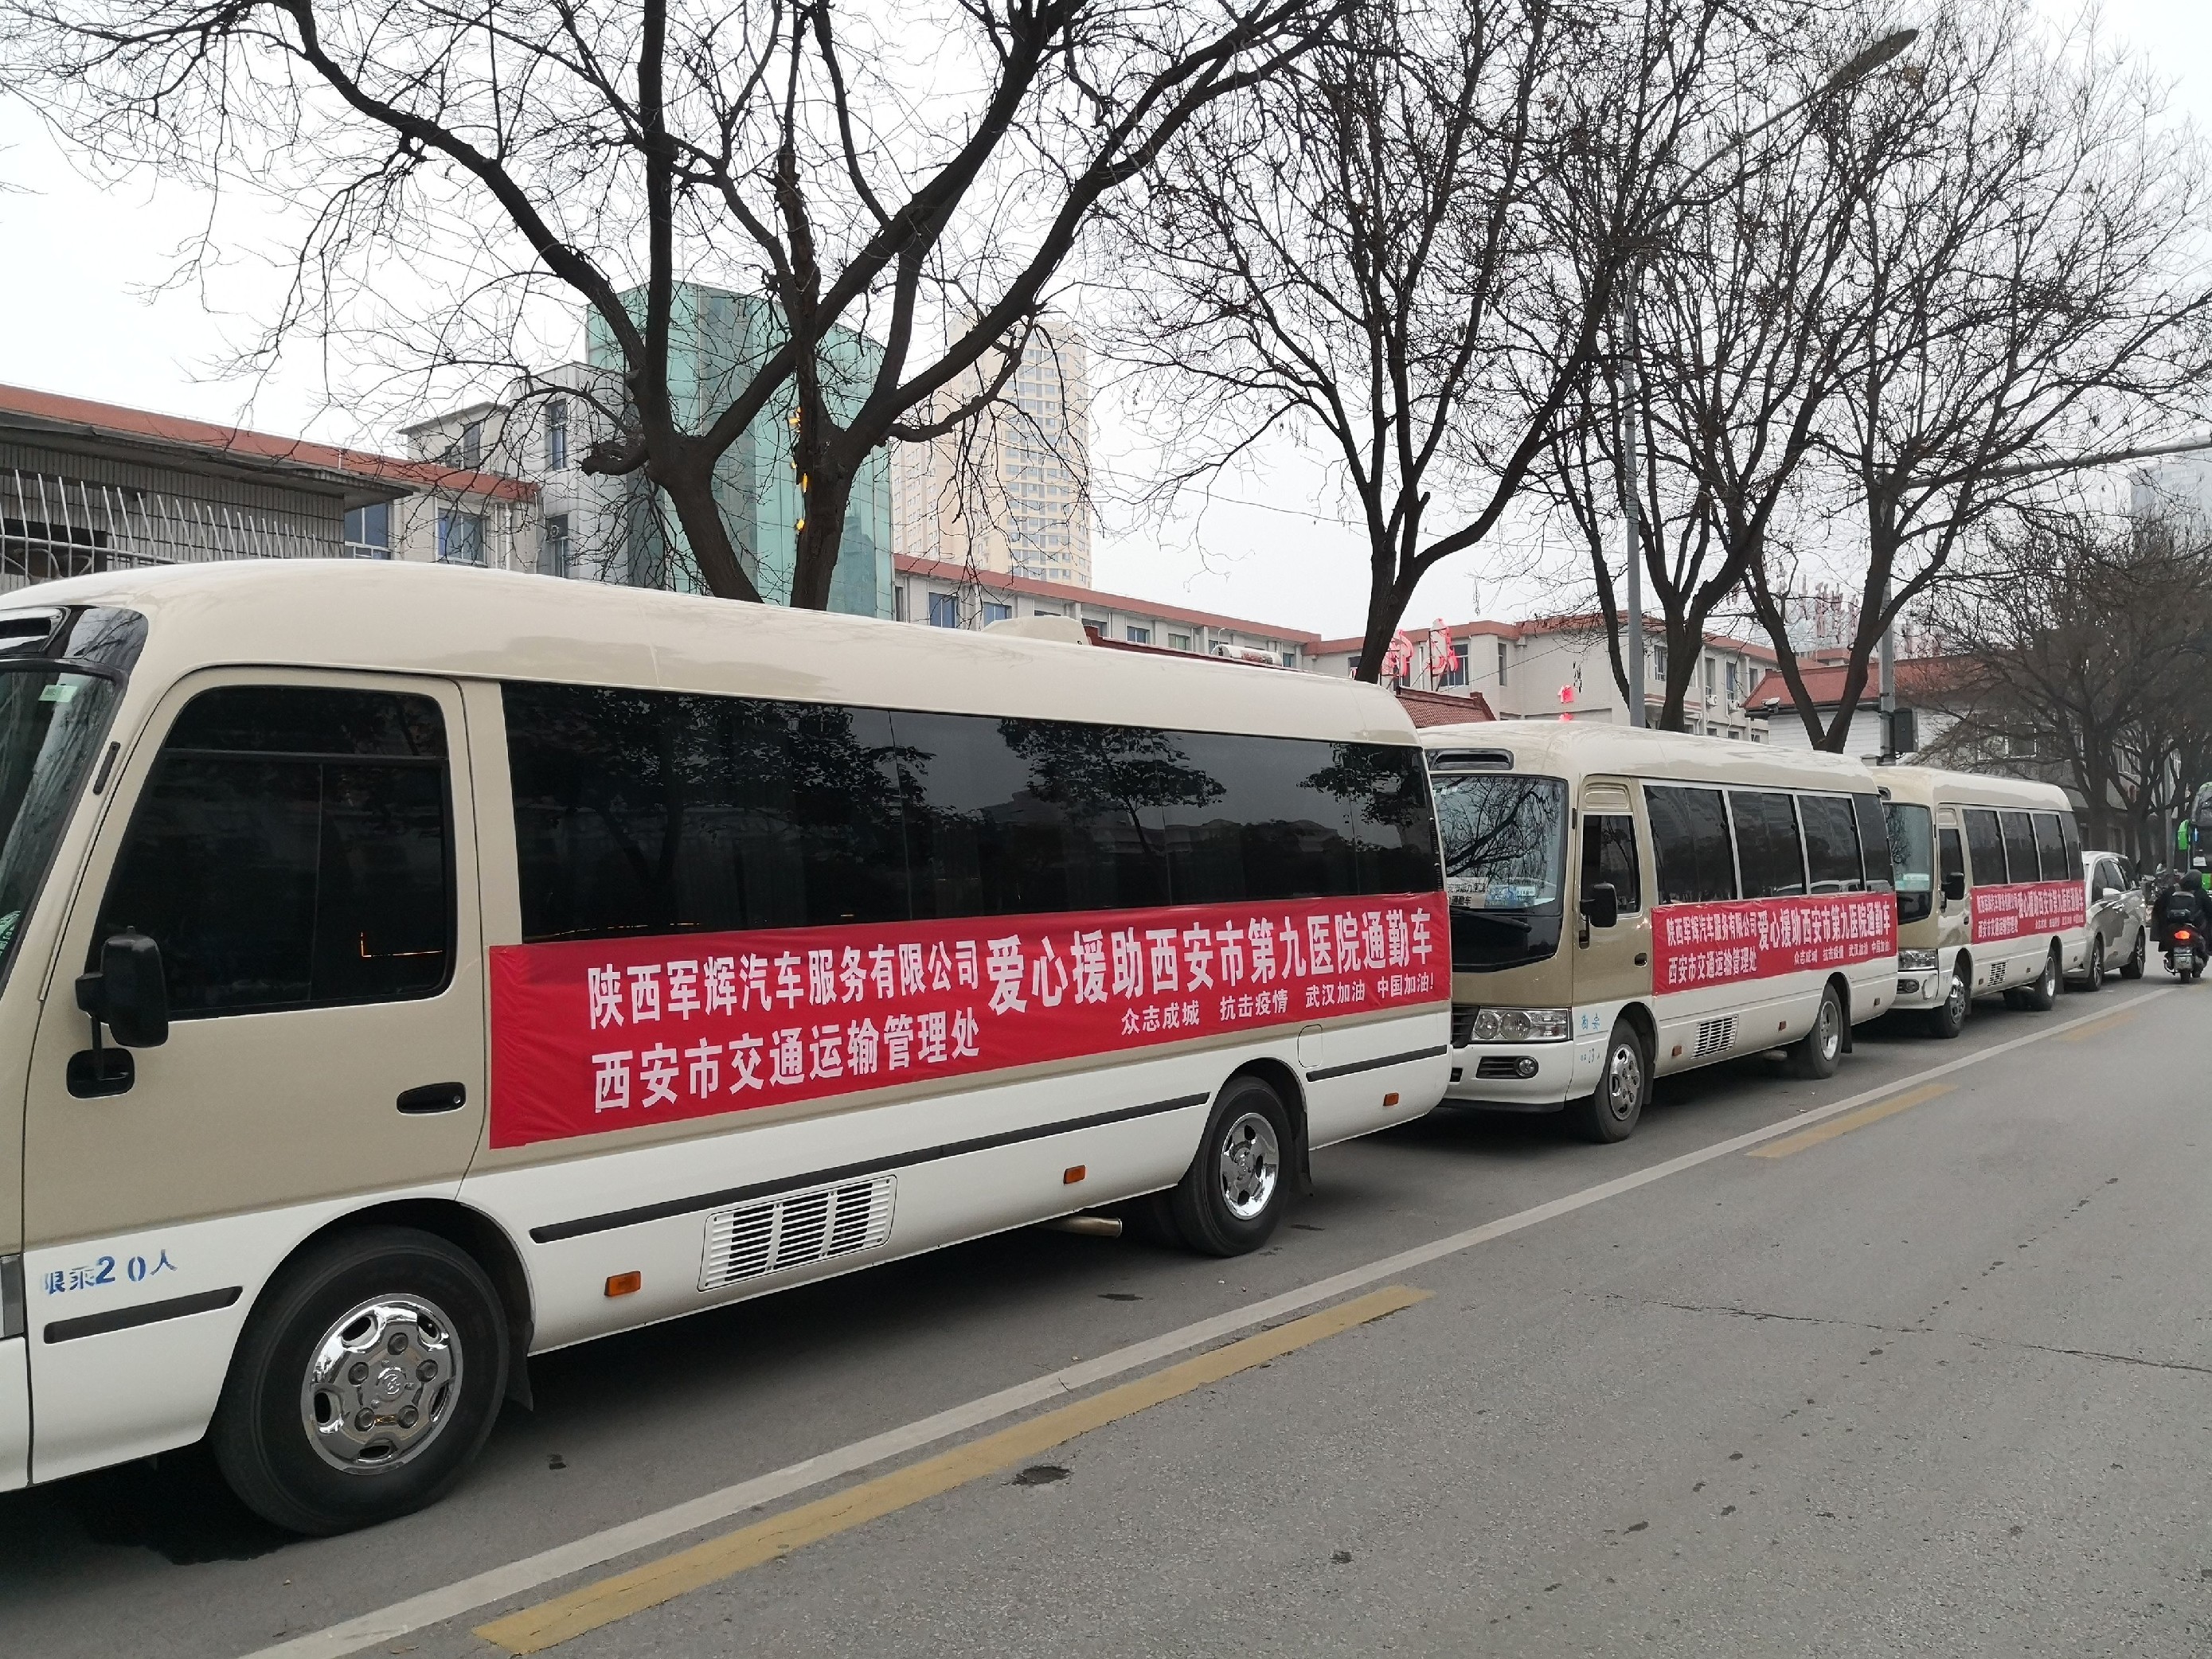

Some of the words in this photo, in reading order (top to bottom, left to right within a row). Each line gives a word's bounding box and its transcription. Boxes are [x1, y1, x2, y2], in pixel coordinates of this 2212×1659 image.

[987, 908, 1433, 1016] 爱心援助西安市第九医院通勤车
[1757, 900, 1891, 951] 爱心援助西安市第九医院通勤车
[588, 939, 979, 1029] 陕西军辉汽车服务有限公司
[1668, 946, 1757, 985] 西安市交通运输管理处
[1121, 1000, 1200, 1035] 众志成城
[1220, 990, 1288, 1021] 抗击疫情
[1305, 979, 1366, 1008] 武汉加油
[591, 1007, 980, 1113] 西安市交通运输管理处
